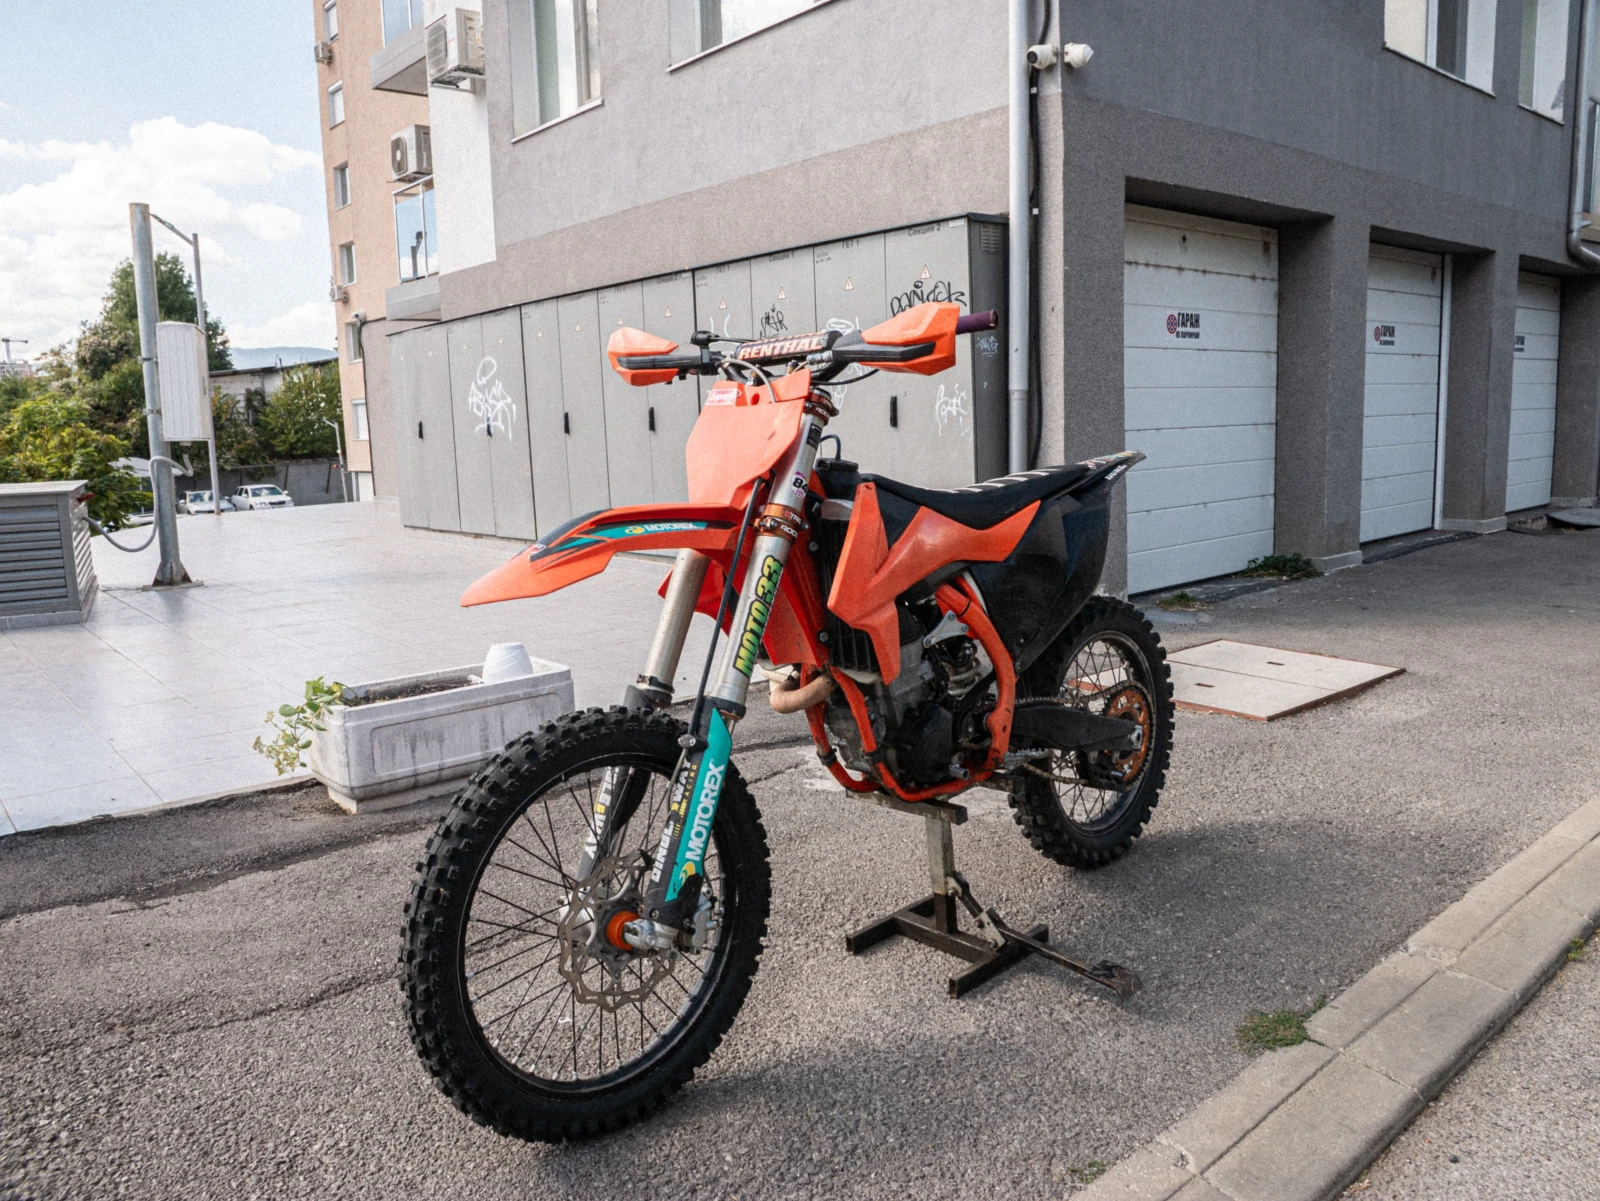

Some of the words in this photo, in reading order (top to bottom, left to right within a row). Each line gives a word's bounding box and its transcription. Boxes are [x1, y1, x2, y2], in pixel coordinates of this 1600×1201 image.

[908, 225, 935, 236] Секция
[1178, 312, 1200, 328] ГАРАЖ
[738, 339, 823, 360] RENTHAL
[644, 522, 697, 532] MOTOREX
[685, 760, 725, 861] MOTOREX
